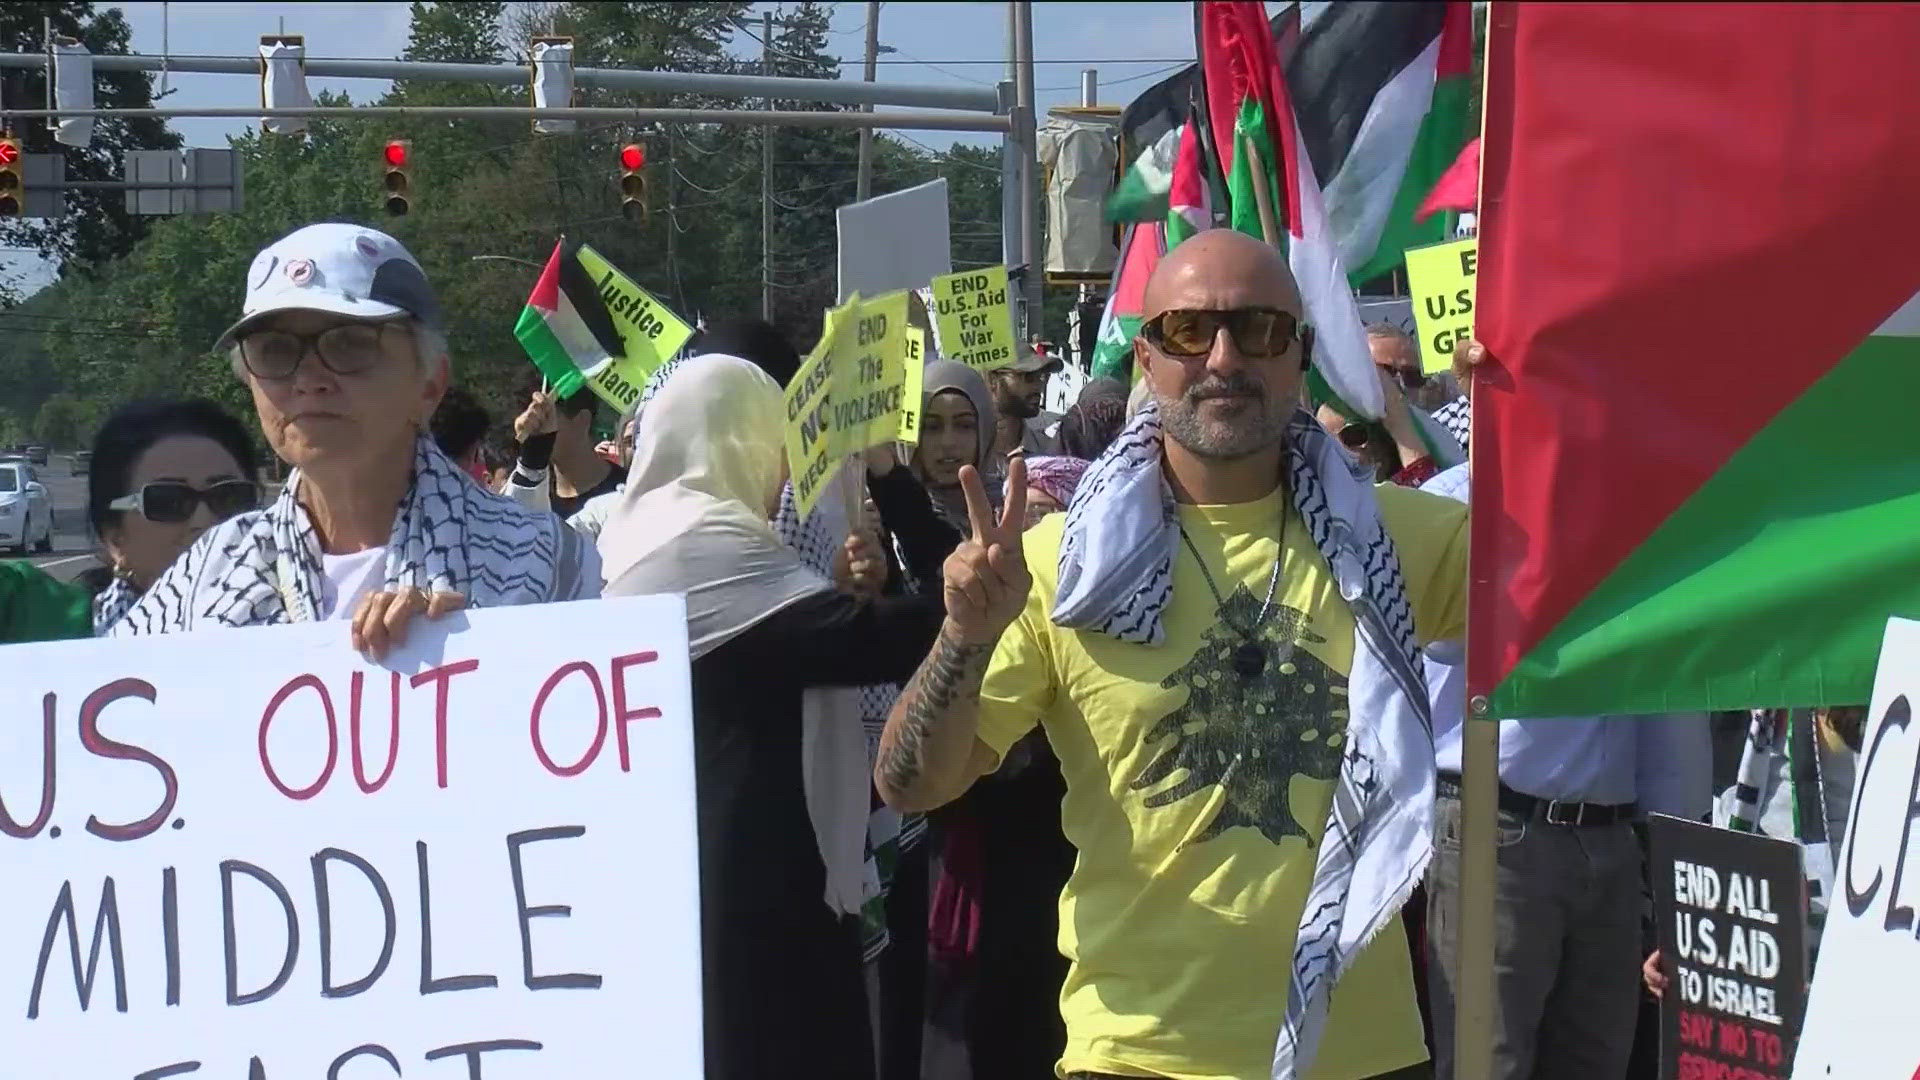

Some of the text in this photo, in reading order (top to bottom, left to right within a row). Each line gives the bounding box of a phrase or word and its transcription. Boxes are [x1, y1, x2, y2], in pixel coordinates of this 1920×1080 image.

[938, 296, 971, 316] U.S.
[976, 289, 1006, 309] Aid
[951, 275, 989, 296] END
[858, 312, 888, 346] END
[960, 312, 988, 331] For
[960, 329, 994, 348] War
[858, 353, 884, 384] The
[834, 382, 901, 433] VIOLENCE
[799, 450, 834, 502] NEG
[258, 659, 480, 801] OUT
[530, 650, 663, 777] OF
[1674, 859, 1780, 925] END ALL
[27, 825, 603, 1020] MIDDLE
[1675, 910, 1781, 980] U.S. AID
[1678, 965, 1784, 1026] TO ISRAEL
[1679, 1010, 1784, 1068] SAY NO TO
